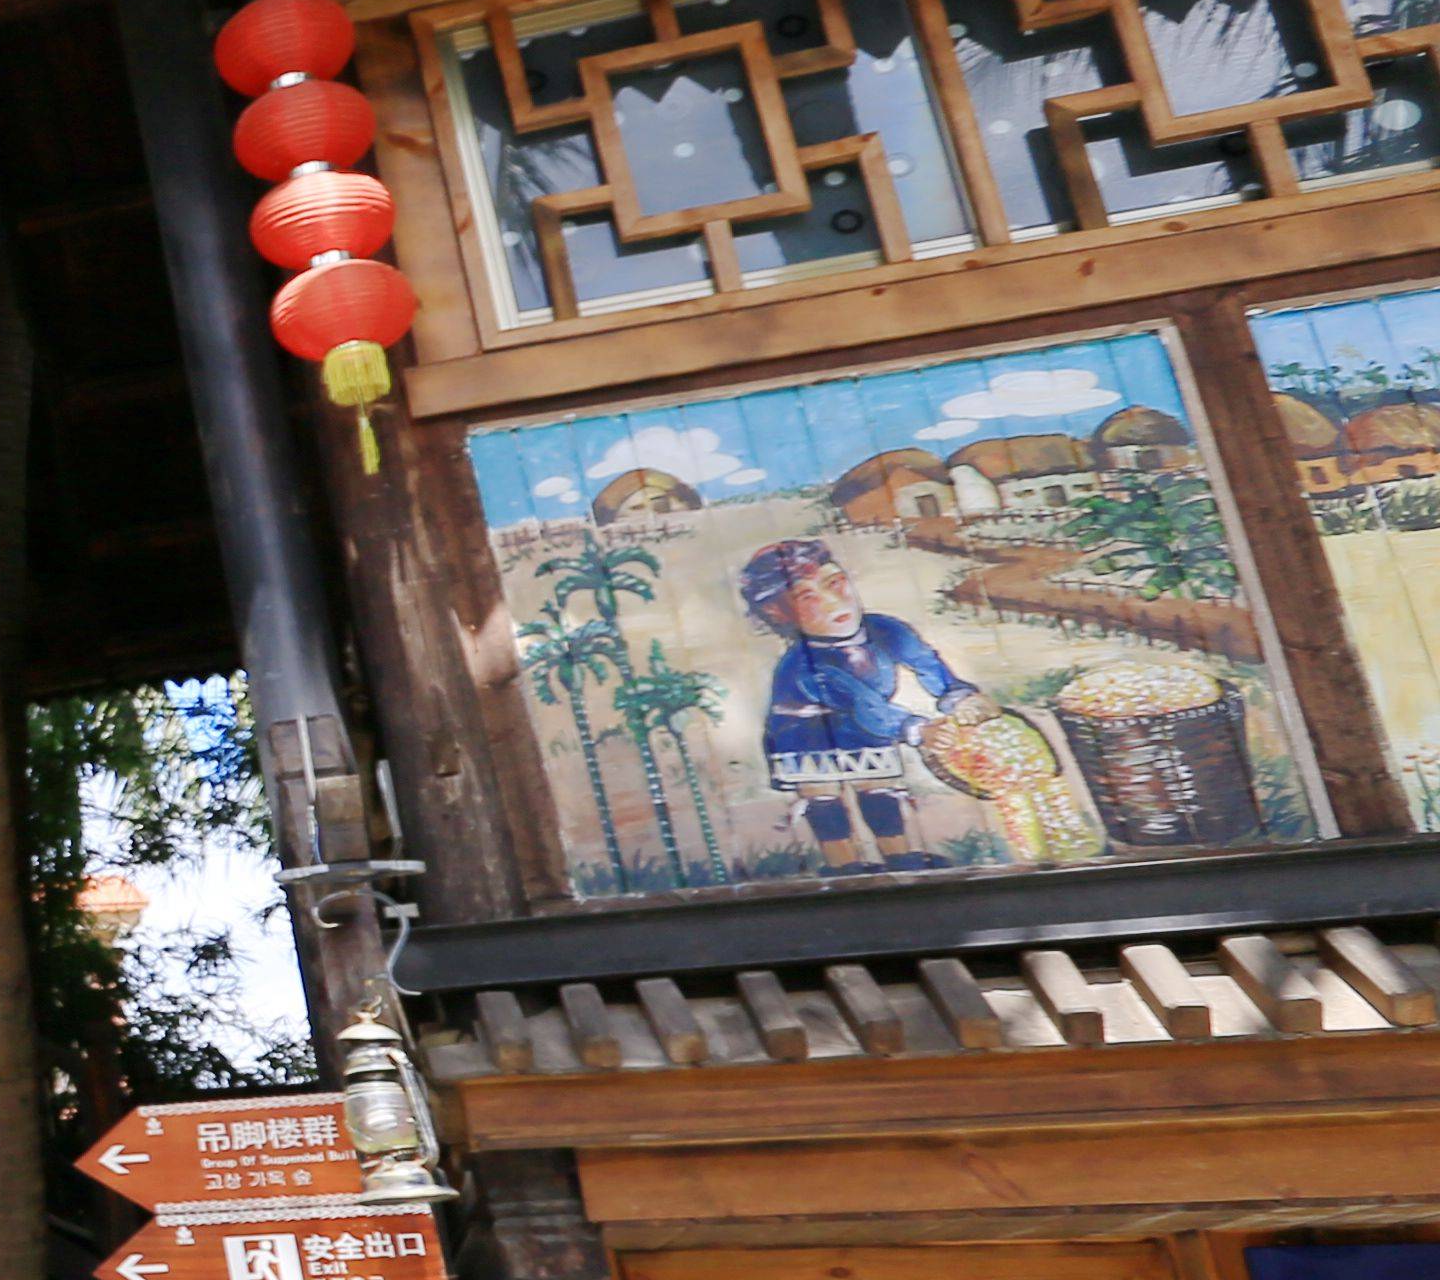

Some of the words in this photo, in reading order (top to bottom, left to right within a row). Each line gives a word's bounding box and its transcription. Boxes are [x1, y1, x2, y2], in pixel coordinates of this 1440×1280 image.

[197, 1114, 340, 1153] 吊脚楼群
[200, 1157, 237, 1169] Group
[240, 1155, 256, 1167] Of
[259, 1152, 324, 1166] Suspended
[302, 1231, 426, 1262] 安全出口
[308, 1261, 349, 1276] Exit
